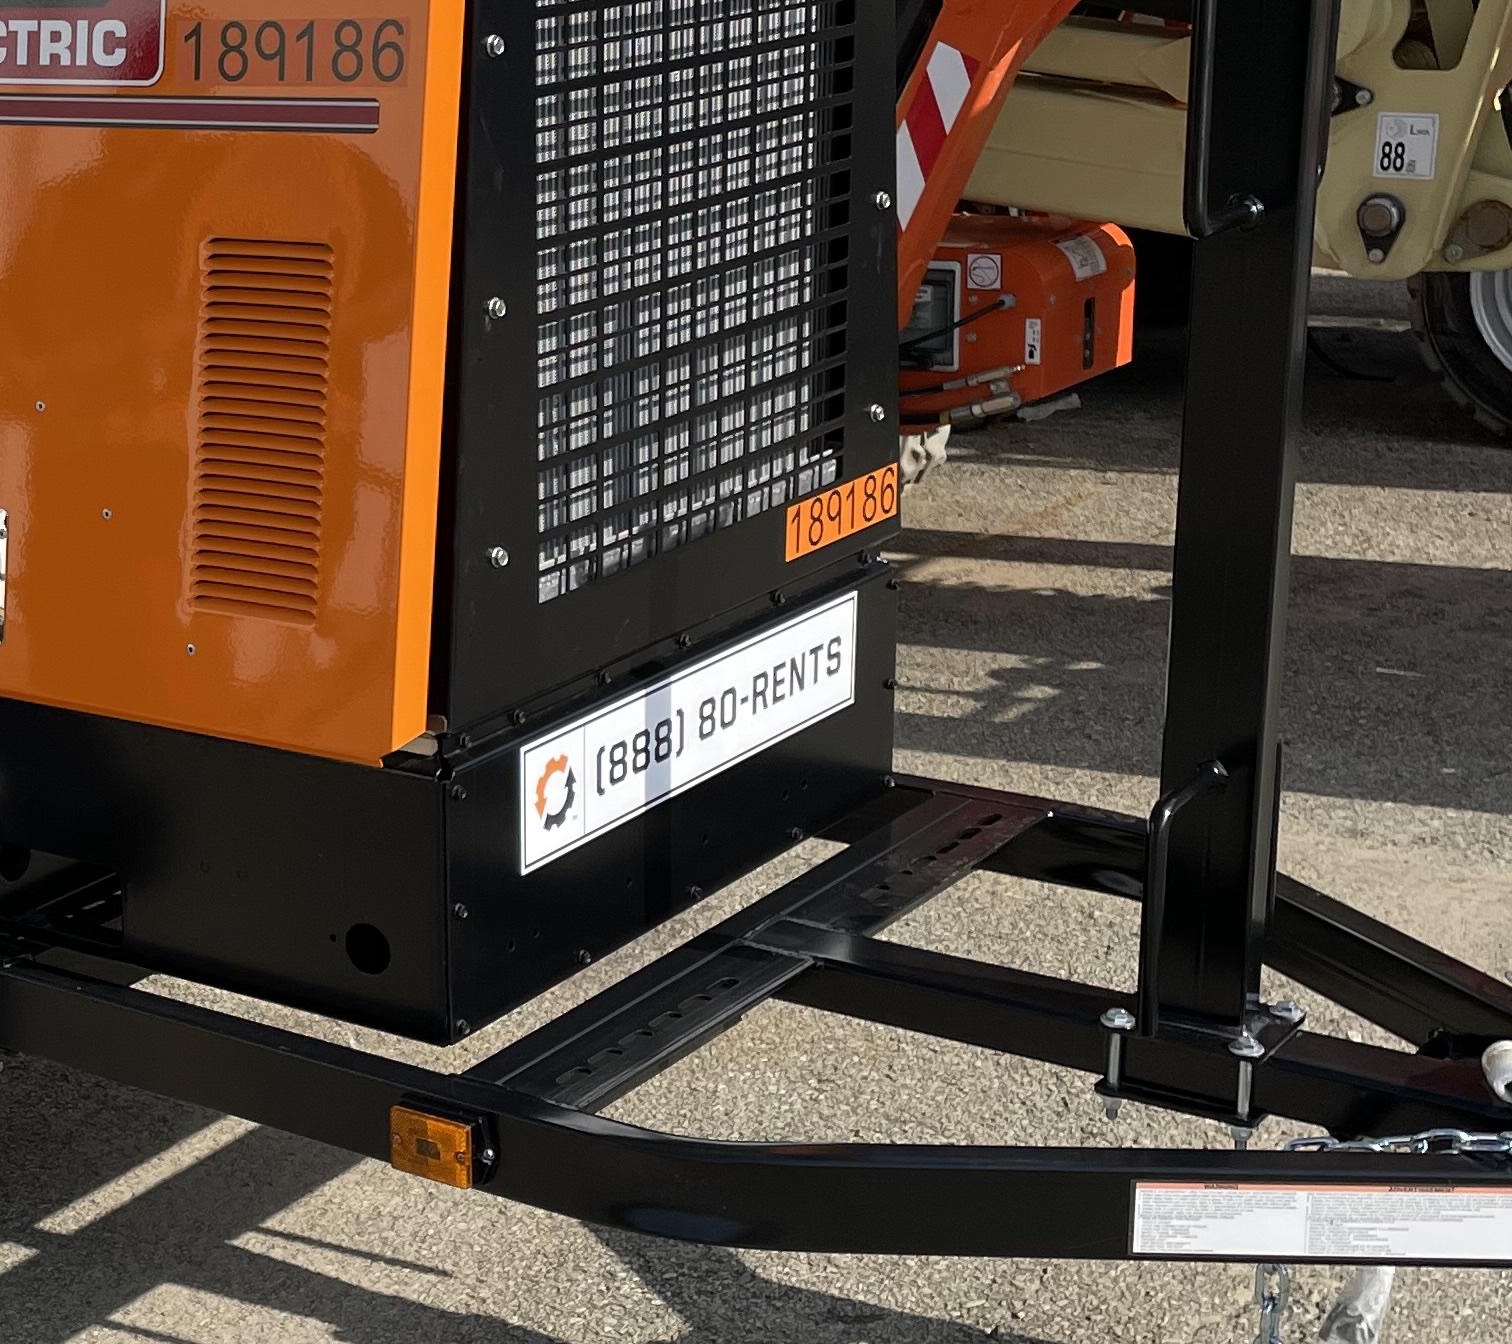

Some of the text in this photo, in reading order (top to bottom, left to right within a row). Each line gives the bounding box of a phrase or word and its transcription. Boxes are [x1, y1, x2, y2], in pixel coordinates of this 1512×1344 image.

[183, 18, 405, 84] 189186
[1380, 141, 1405, 172] 88
[791, 466, 896, 555] 189186
[596, 635, 843, 797] (888) 80-RENTS
